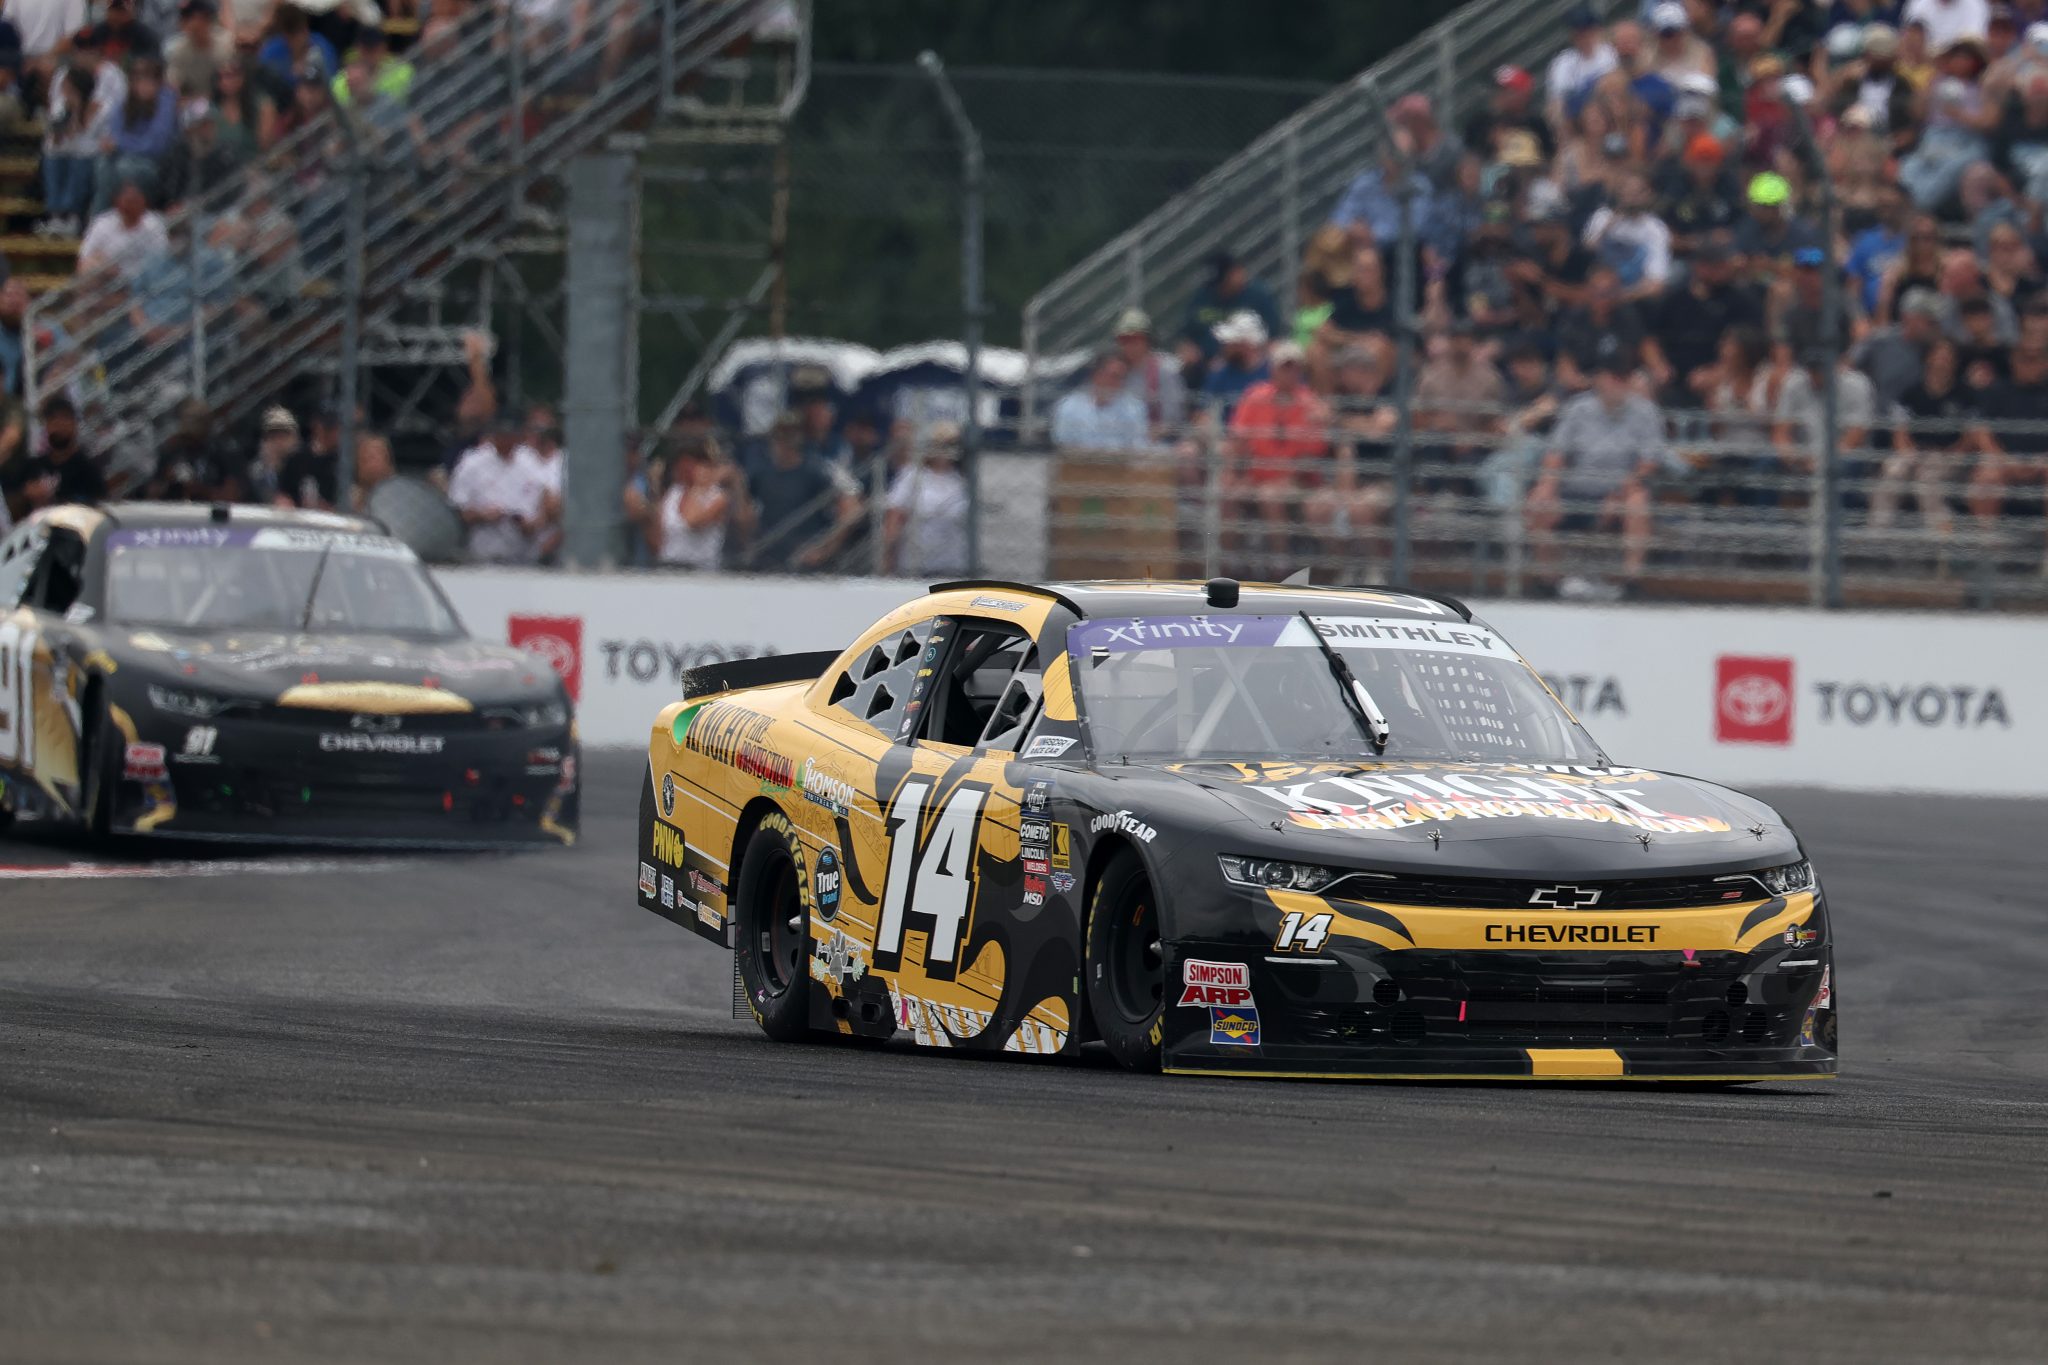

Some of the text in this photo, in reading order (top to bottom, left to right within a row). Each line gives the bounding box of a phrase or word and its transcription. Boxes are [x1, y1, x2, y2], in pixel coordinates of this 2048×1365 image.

[1104, 617, 1244, 646] xfinity
[1319, 622, 1493, 650] SMITHLEY
[1813, 681, 2010, 729] TOYOTA
[319, 733, 446, 753] CHEVROLET
[685, 701, 759, 767] KNIGHT
[1243, 774, 1667, 818] KNIGHT
[1091, 810, 1158, 844] GOODYEAR
[1305, 804, 1425, 830] FIRE
[1020, 823, 1050, 841] COMETIC
[1021, 845, 1045, 861] LINCOLN
[876, 777, 970, 962] 14
[1026, 861, 1047, 873] WELDERS
[817, 870, 839, 894] True
[1022, 891, 1043, 906] MSD
[1278, 912, 1334, 951] 14
[1485, 925, 1660, 943] CHEVROLET
[1189, 964, 1243, 985] SIMPSON
[1180, 985, 1252, 1006] ARP
[1215, 1021, 1256, 1032] SUNOCO
